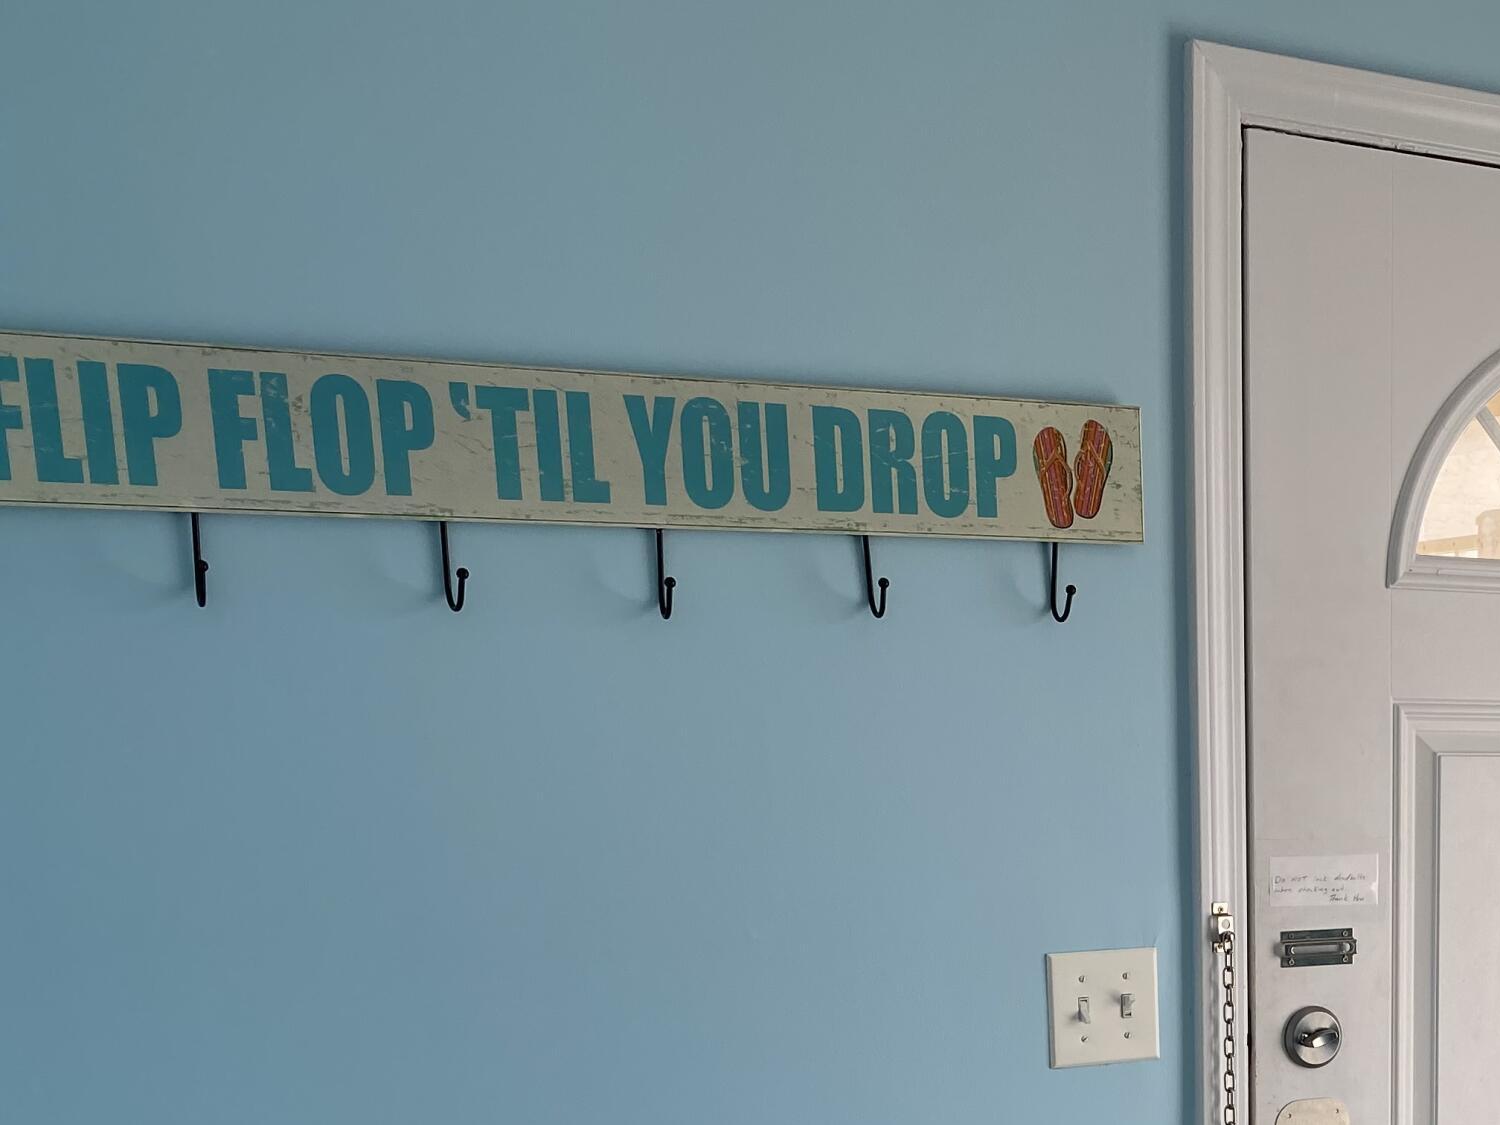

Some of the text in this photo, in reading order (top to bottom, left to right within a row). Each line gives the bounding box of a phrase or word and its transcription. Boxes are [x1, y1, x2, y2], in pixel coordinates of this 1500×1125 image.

[207, 368, 436, 497] FLOP
[449, 381, 611, 505] 'TIL
[622, 394, 791, 512] YOU
[811, 404, 1018, 519] DROP
